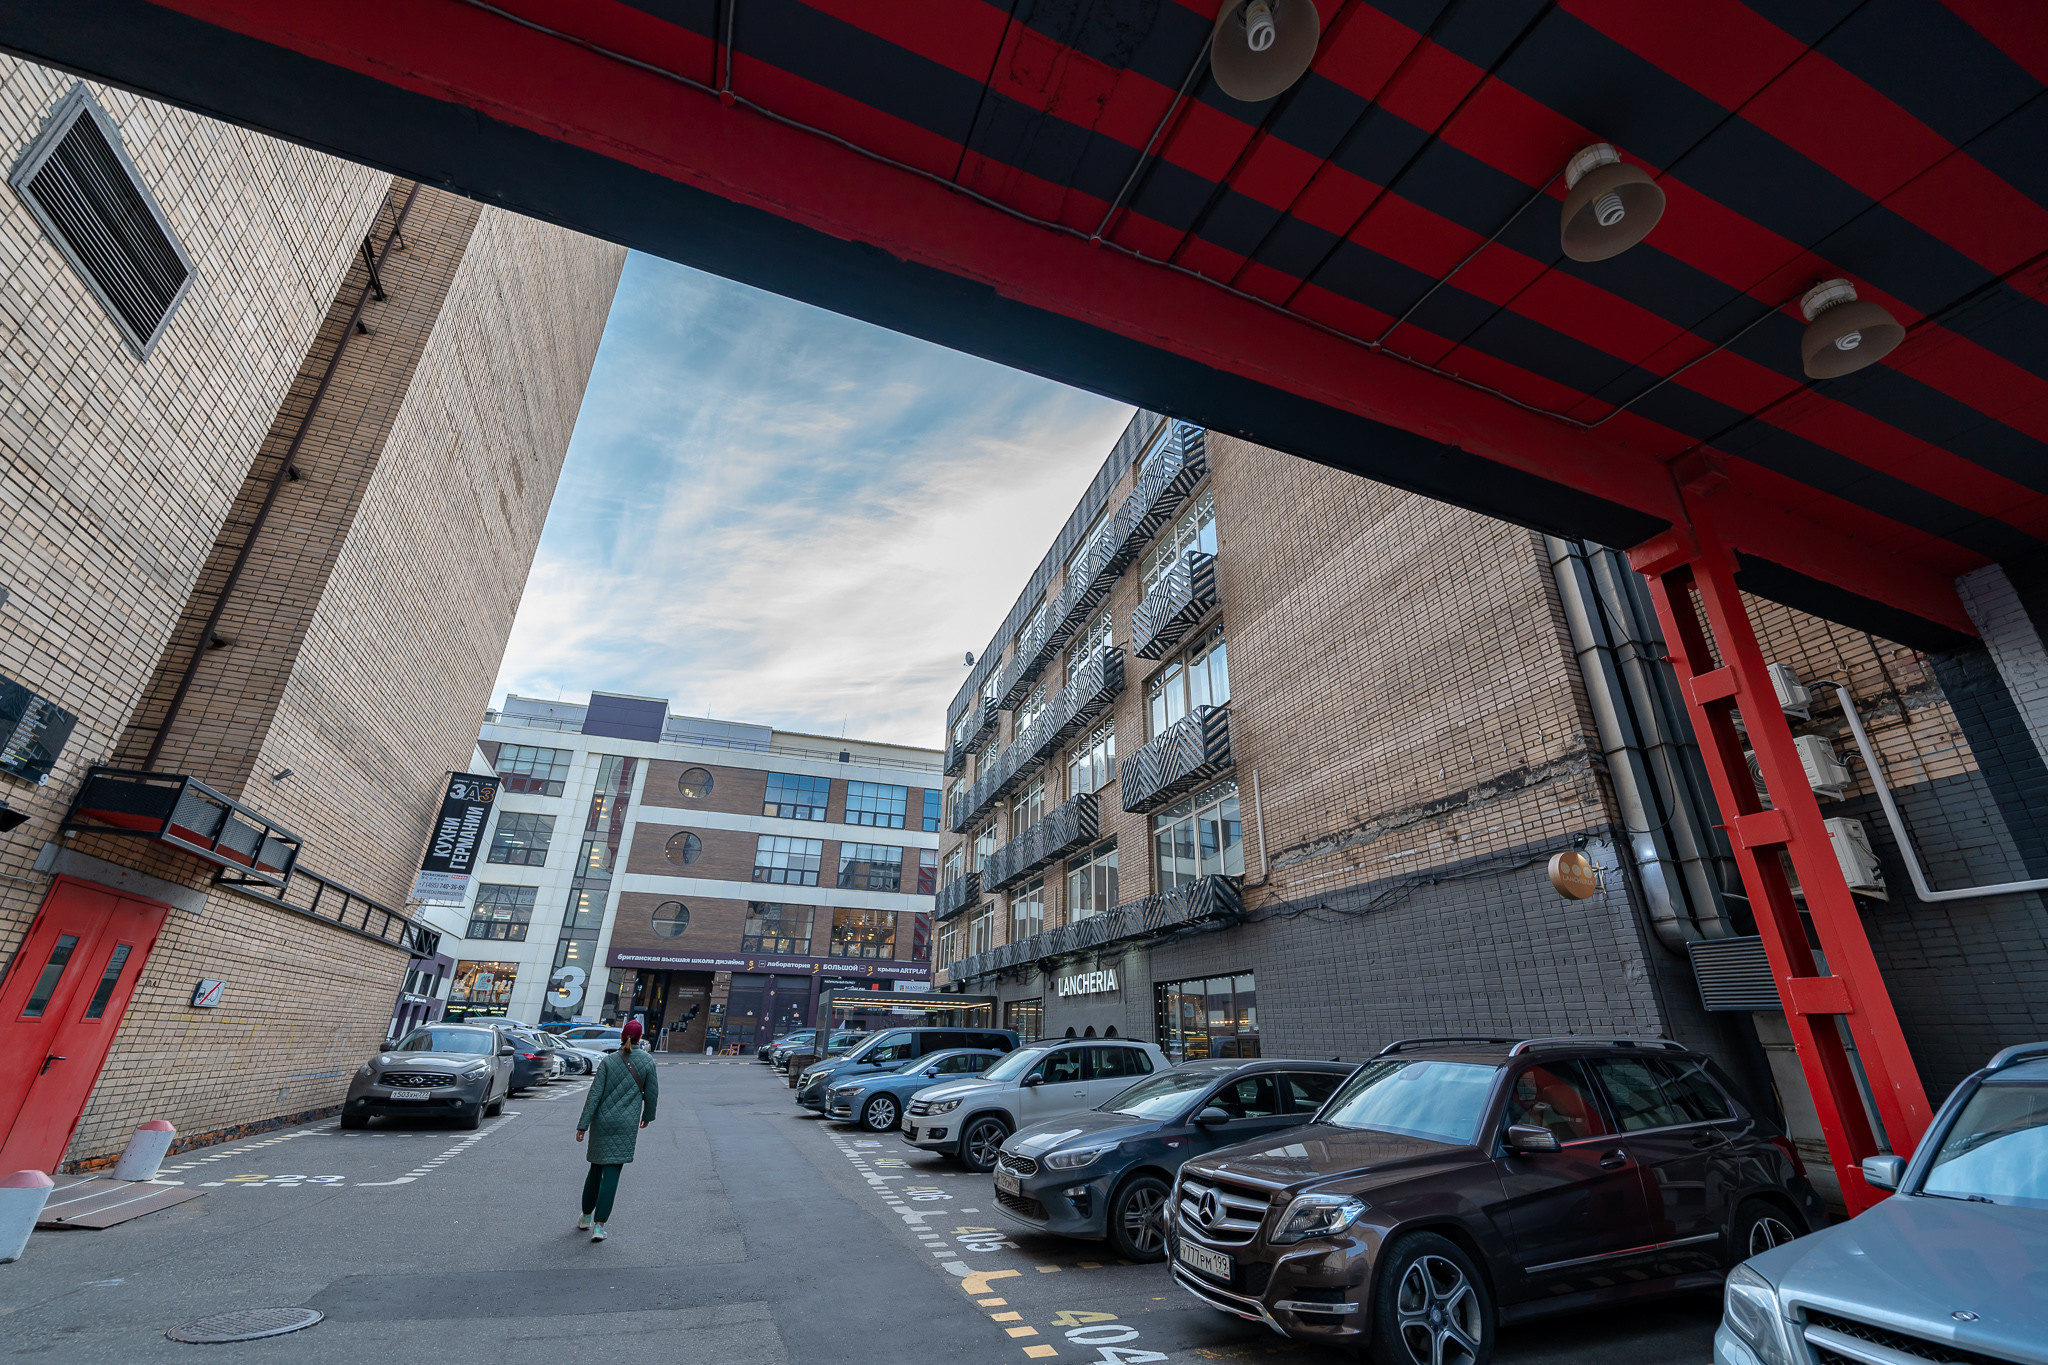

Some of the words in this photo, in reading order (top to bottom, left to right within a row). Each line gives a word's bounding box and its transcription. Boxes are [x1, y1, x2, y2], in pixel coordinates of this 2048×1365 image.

[38, 773, 49, 786] 9
[433, 817, 461, 857] КУХНИ
[449, 806, 485, 870] ГЕРМАНИИ
[617, 953, 660, 962] британская
[714, 958, 745, 966] дизайна
[766, 961, 811, 969] лаборатория
[823, 963, 858, 972] БОЛЬШОЙ
[547, 966, 586, 1008] 3
[1058, 969, 1119, 997] LANCHERIA
[221, 1174, 346, 1183] 223
[902, 1186, 954, 1201] 406
[950, 1226, 1021, 1252] 405
[1212, 1254, 1228, 1271] 199
[1050, 1310, 1170, 1365] 404
